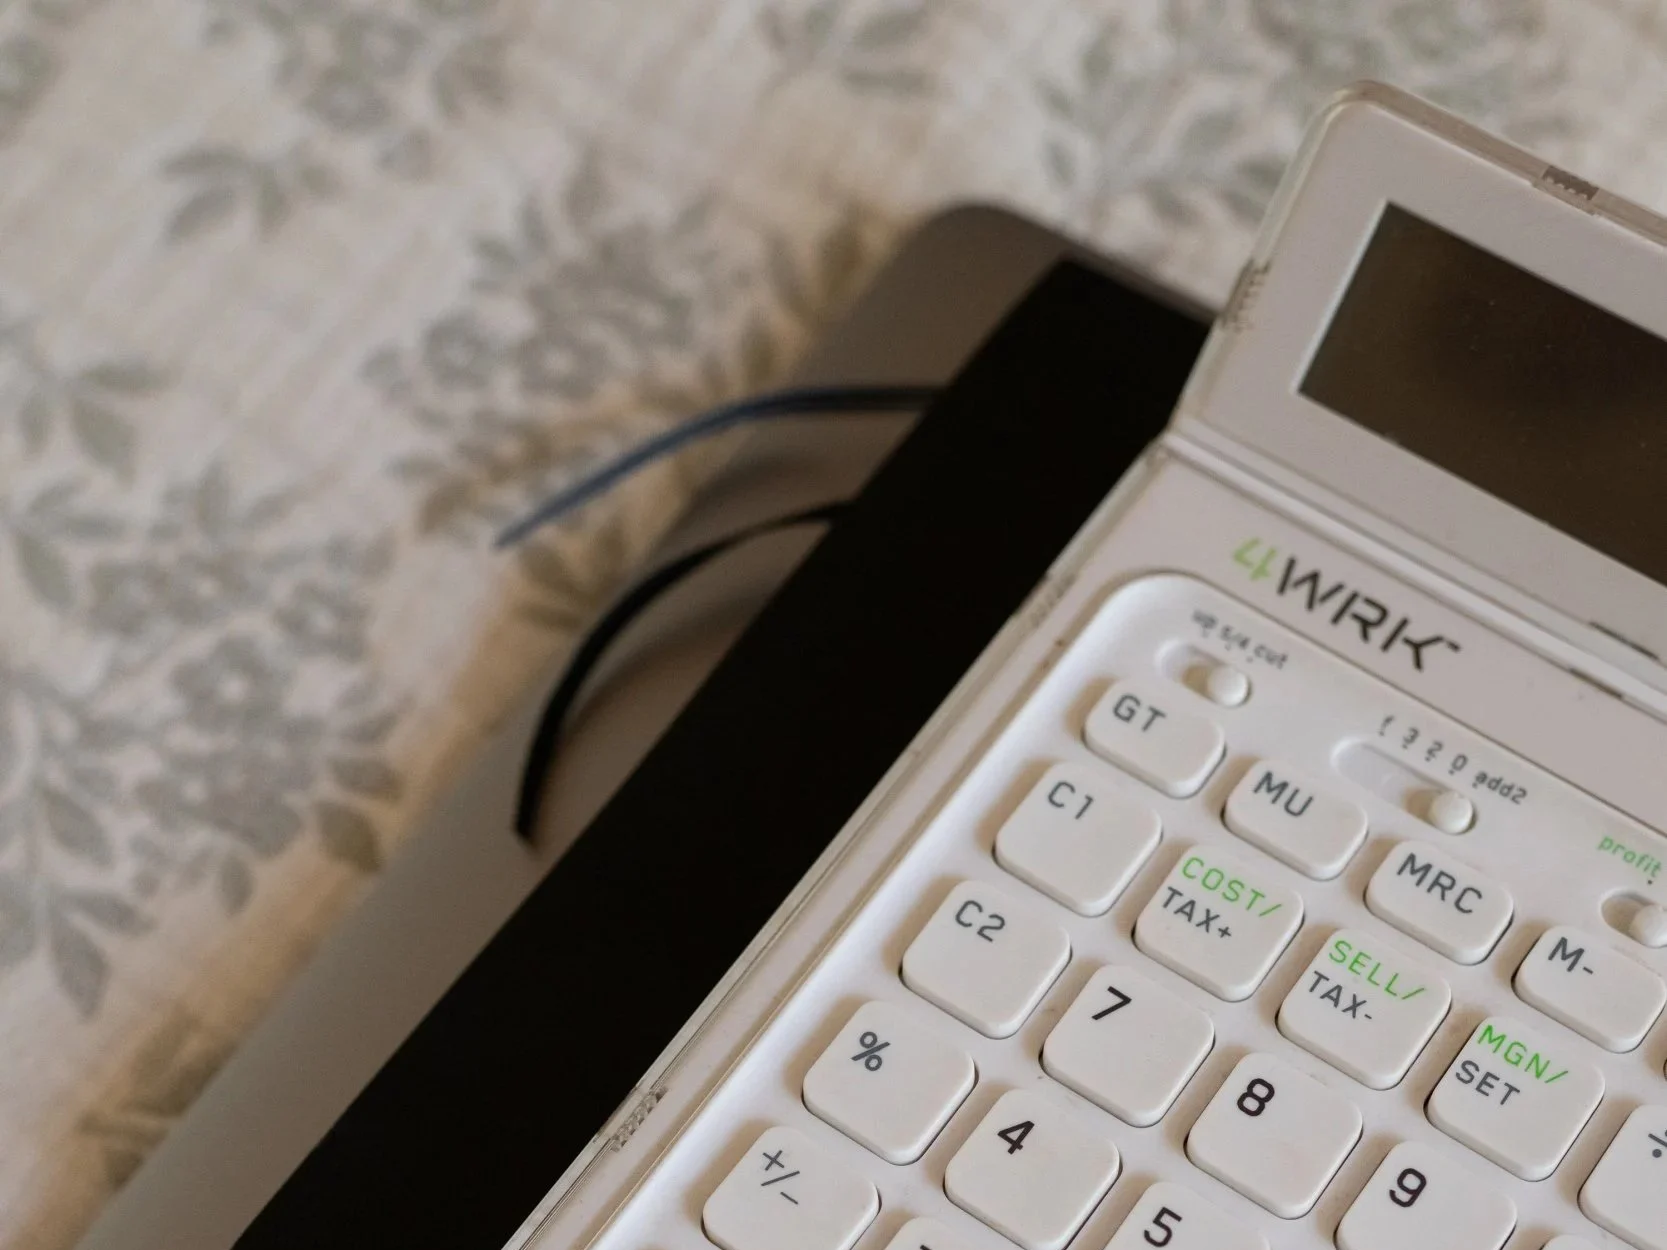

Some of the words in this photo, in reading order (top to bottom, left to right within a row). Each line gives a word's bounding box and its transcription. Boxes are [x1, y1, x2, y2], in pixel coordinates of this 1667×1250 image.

[1254, 643, 1288, 669] cut
[1111, 693, 1166, 732] GT
[1047, 781, 1094, 820] C1
[1252, 770, 1314, 818] MU
[1473, 770, 1528, 805] add2
[1597, 835, 1662, 878] profit
[1180, 856, 1284, 917] COST/
[1396, 852, 1483, 915] MRC
[954, 899, 1006, 943] C2
[1162, 886, 1232, 939] TAX+
[1327, 938, 1426, 1000] SELL/
[1547, 936, 1594, 977] M-
[1091, 985, 1133, 1021] 7
[1307, 970, 1373, 1022] TAX-
[850, 1031, 891, 1072] %
[1476, 1023, 1571, 1083] MGN/
[1235, 1077, 1276, 1118] 8
[1454, 1059, 1521, 1107] SET
[997, 1120, 1036, 1156] 4
[1388, 1167, 1428, 1209] 9
[1143, 1206, 1183, 1249] 5
